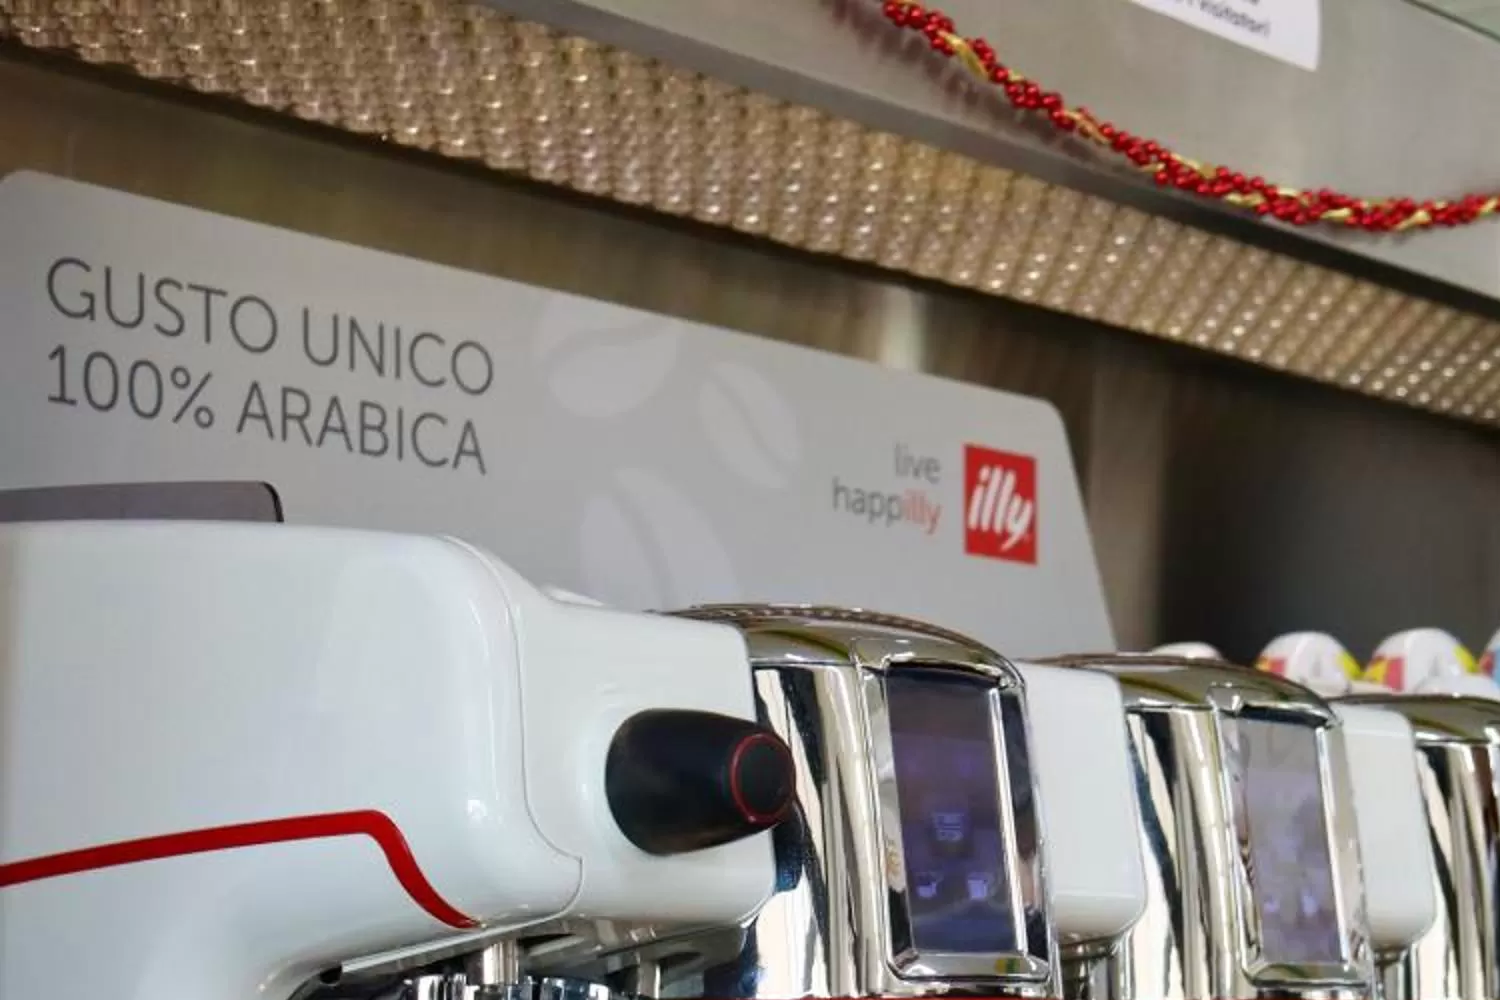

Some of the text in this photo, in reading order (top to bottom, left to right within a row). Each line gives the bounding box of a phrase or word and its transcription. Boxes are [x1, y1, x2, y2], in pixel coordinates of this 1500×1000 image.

[47, 257, 495, 396] GUSTO UNICO
[47, 344, 487, 475] 100% ARABICA
[893, 443, 942, 484] live
[967, 464, 1034, 552] illy
